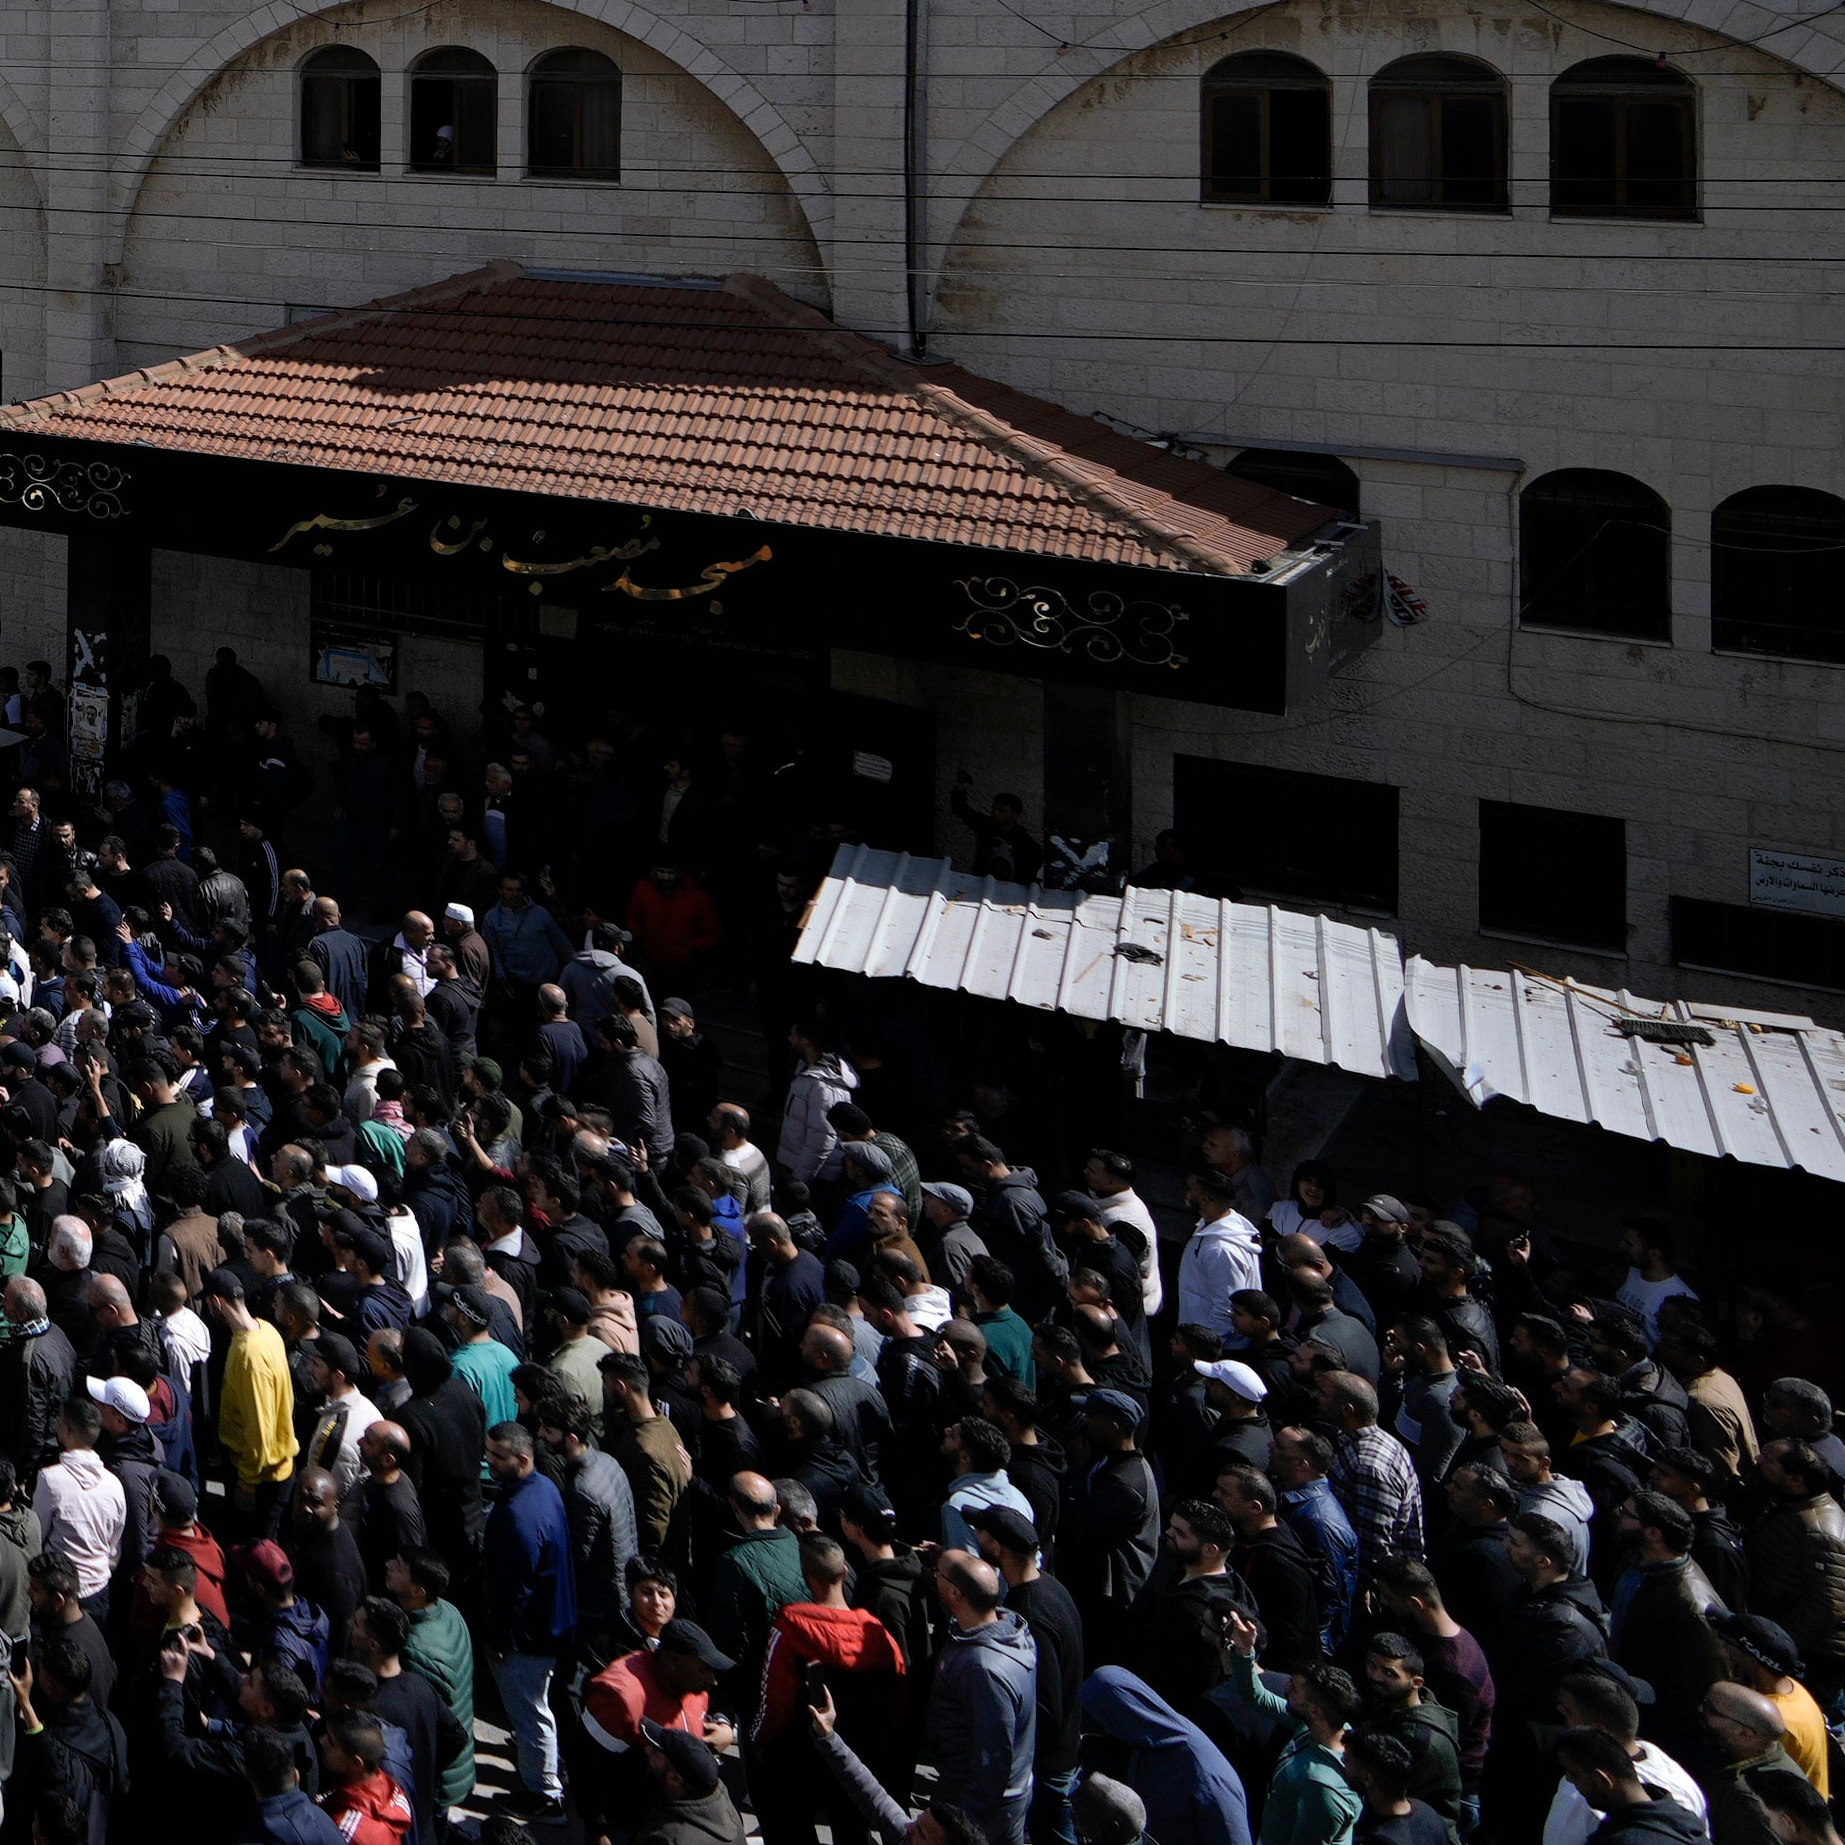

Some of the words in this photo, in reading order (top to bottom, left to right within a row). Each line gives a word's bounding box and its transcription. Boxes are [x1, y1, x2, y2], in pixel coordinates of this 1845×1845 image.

[265, 481, 421, 558] عمير
[429, 512, 494, 558] بن
[501, 513, 662, 598] مصعب
[600, 542, 774, 619] مسجد
[1788, 861, 1823, 874] نفسك
[452, 1291, 489, 1327] adidas
